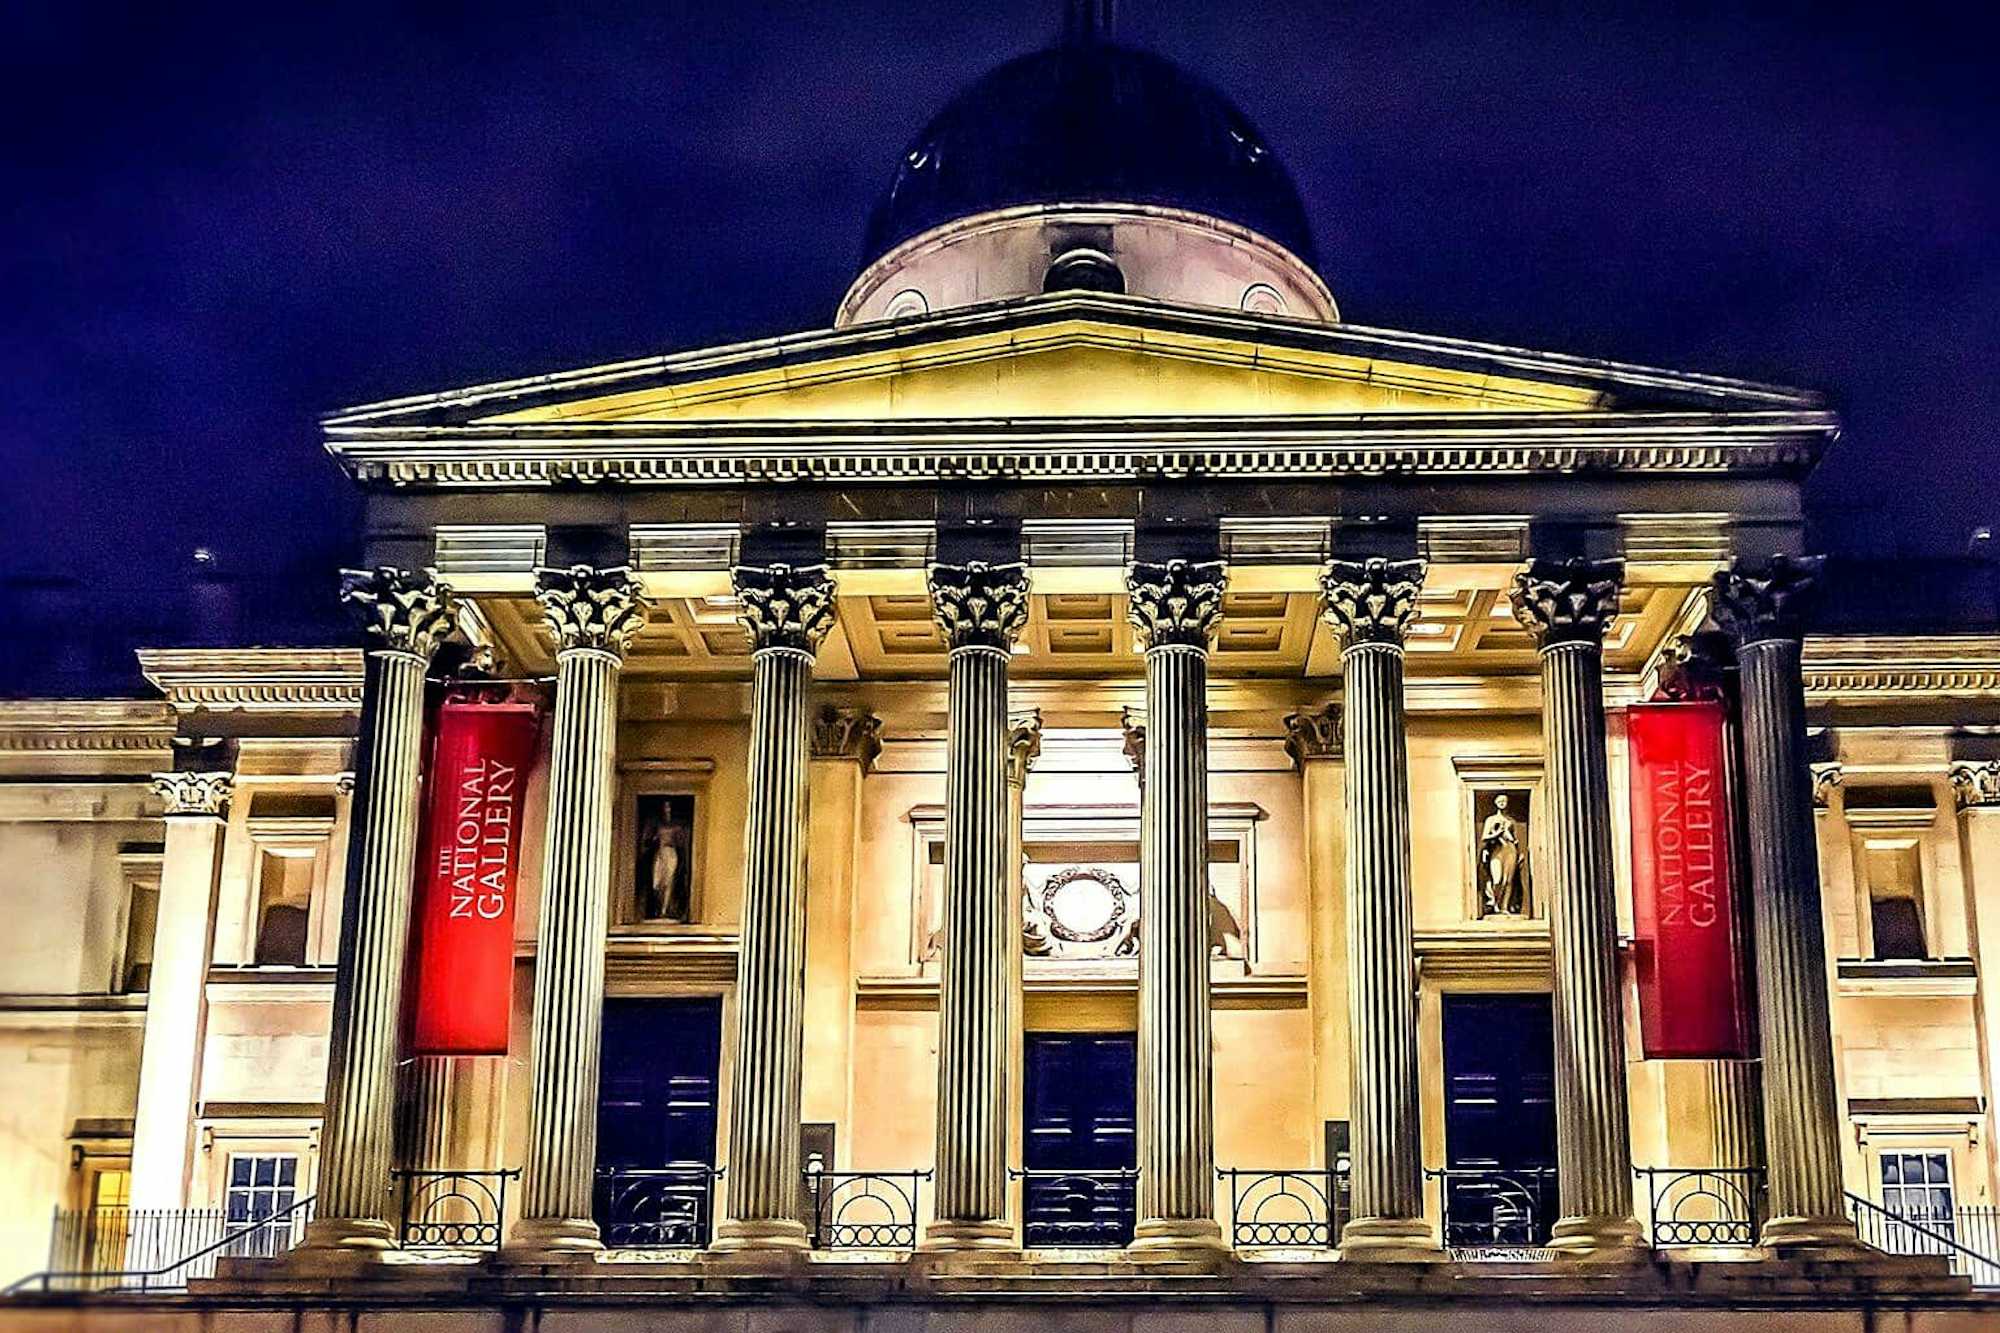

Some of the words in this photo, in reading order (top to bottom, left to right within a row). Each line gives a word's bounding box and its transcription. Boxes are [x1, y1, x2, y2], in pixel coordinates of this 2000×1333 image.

[450, 758, 486, 918] NATIONAL
[477, 760, 515, 919] GALLERY
[1657, 760, 1684, 926] NATIONAL
[1685, 760, 1716, 927] GALLERY
